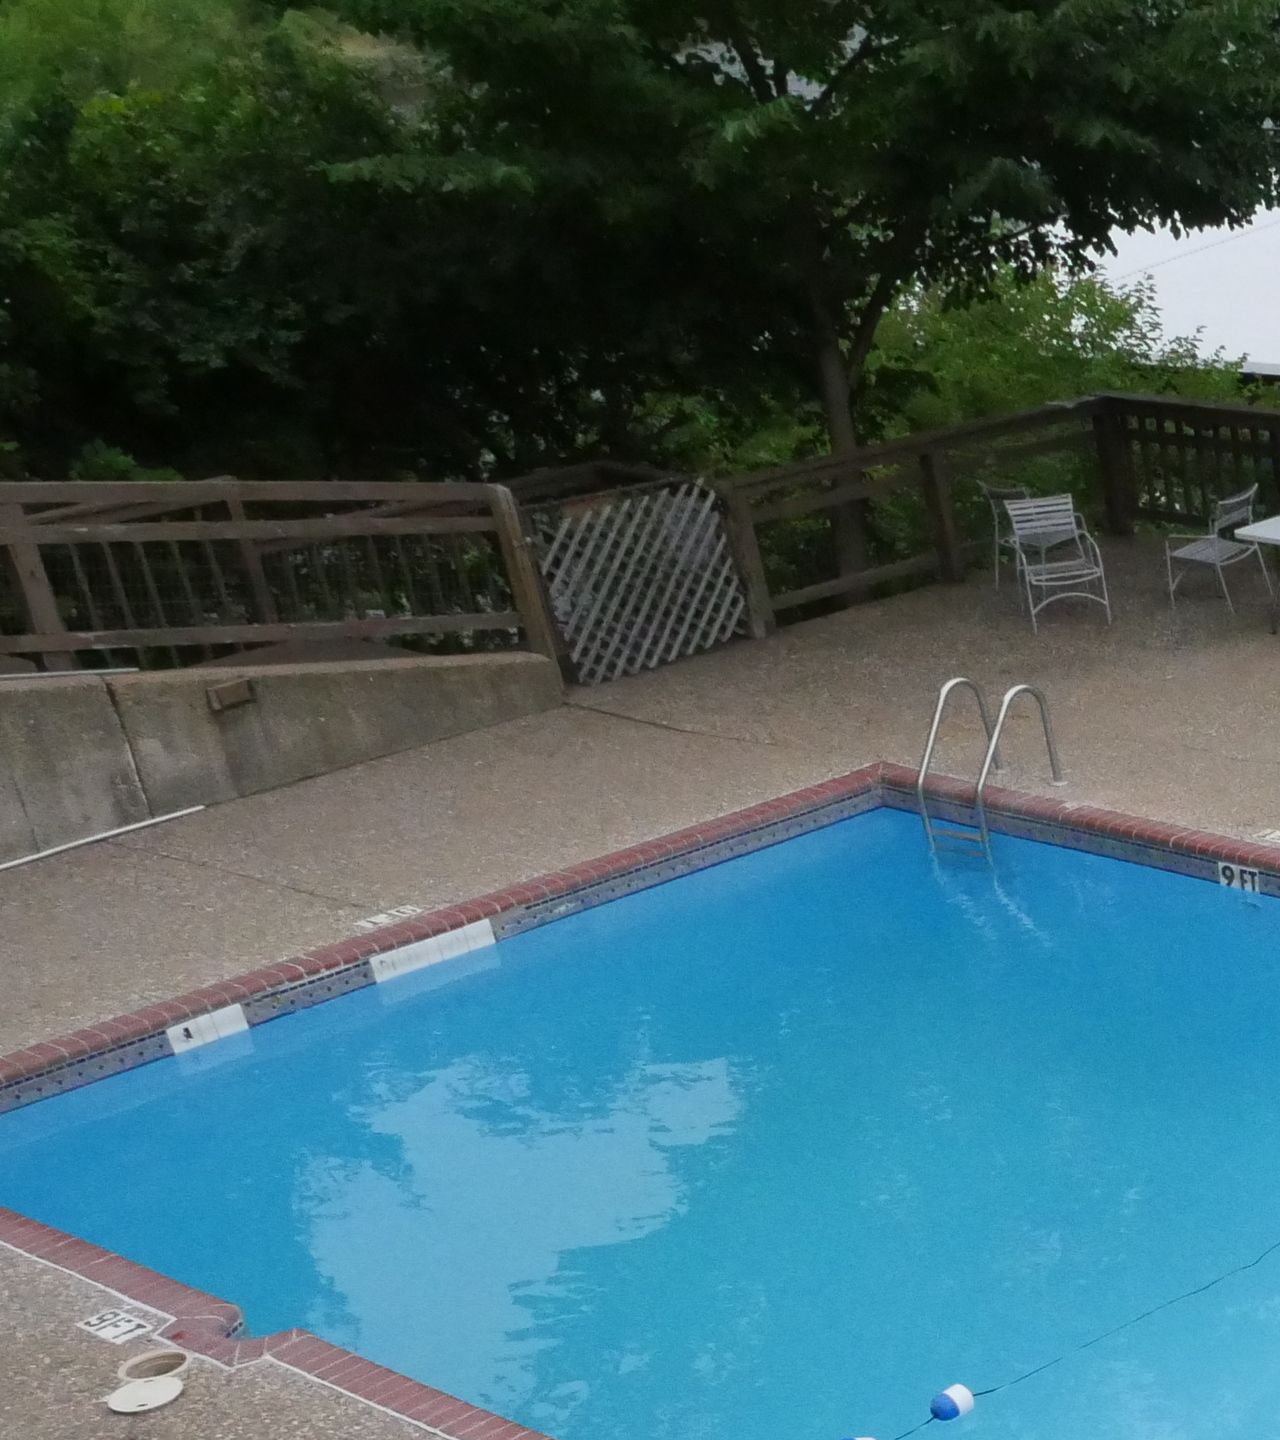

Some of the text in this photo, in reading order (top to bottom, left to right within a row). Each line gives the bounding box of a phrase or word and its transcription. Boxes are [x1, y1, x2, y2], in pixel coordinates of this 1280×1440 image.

[1221, 865, 1258, 893] 9 FT
[83, 1311, 148, 1340] 9FT
